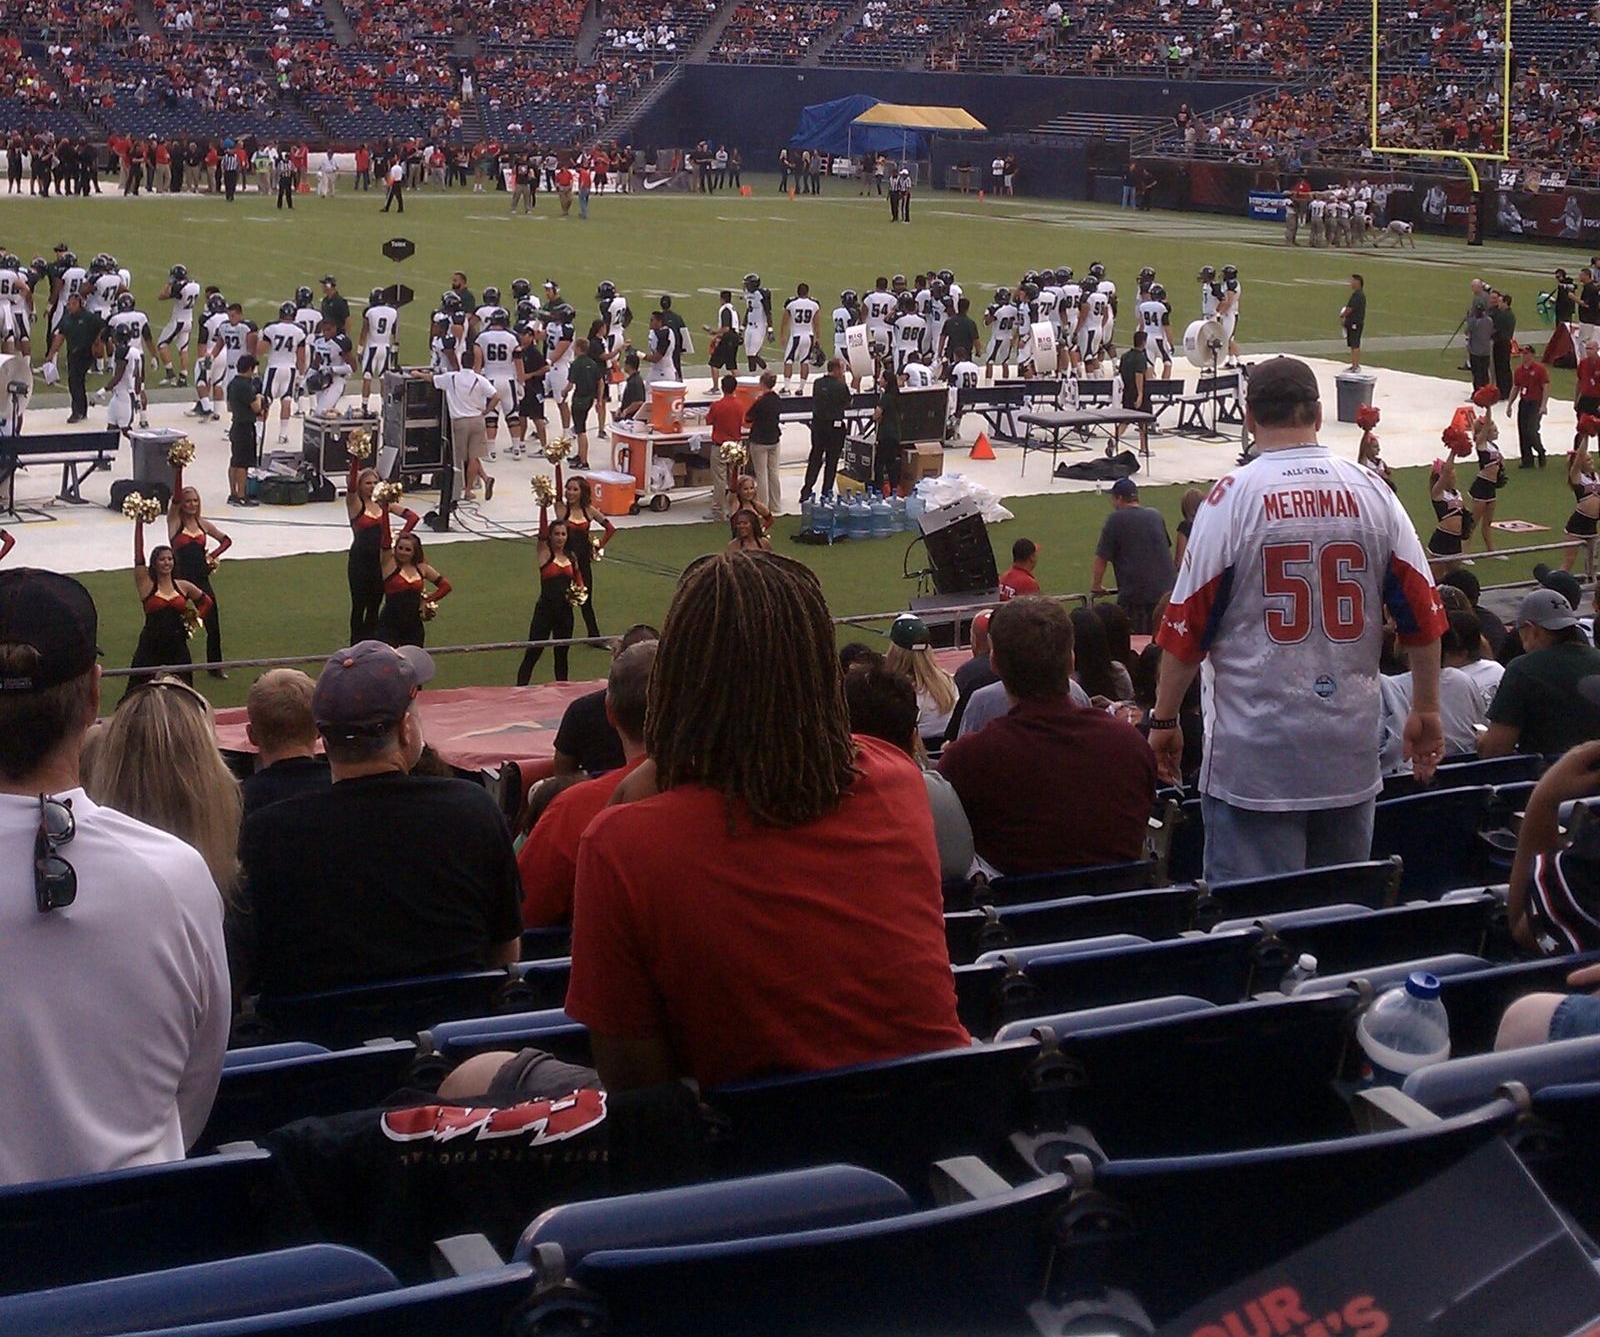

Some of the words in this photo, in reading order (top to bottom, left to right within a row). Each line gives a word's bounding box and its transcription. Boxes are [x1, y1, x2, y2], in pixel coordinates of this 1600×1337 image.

[1499, 173, 1516, 186] 34
[795, 308, 813, 324] 39
[871, 303, 889, 318] 54
[377, 317, 388, 334] 9
[1144, 311, 1159, 327] 94
[902, 326, 920, 341] 88
[274, 334, 294, 352] 74
[487, 343, 508, 361] 66
[919, 370, 928, 386] 5
[671, 398, 684, 411] G
[1287, 466, 1323, 478] ALL-STAR
[1263, 489, 1360, 521] MERRIMAN
[1261, 540, 1367, 645] 56
